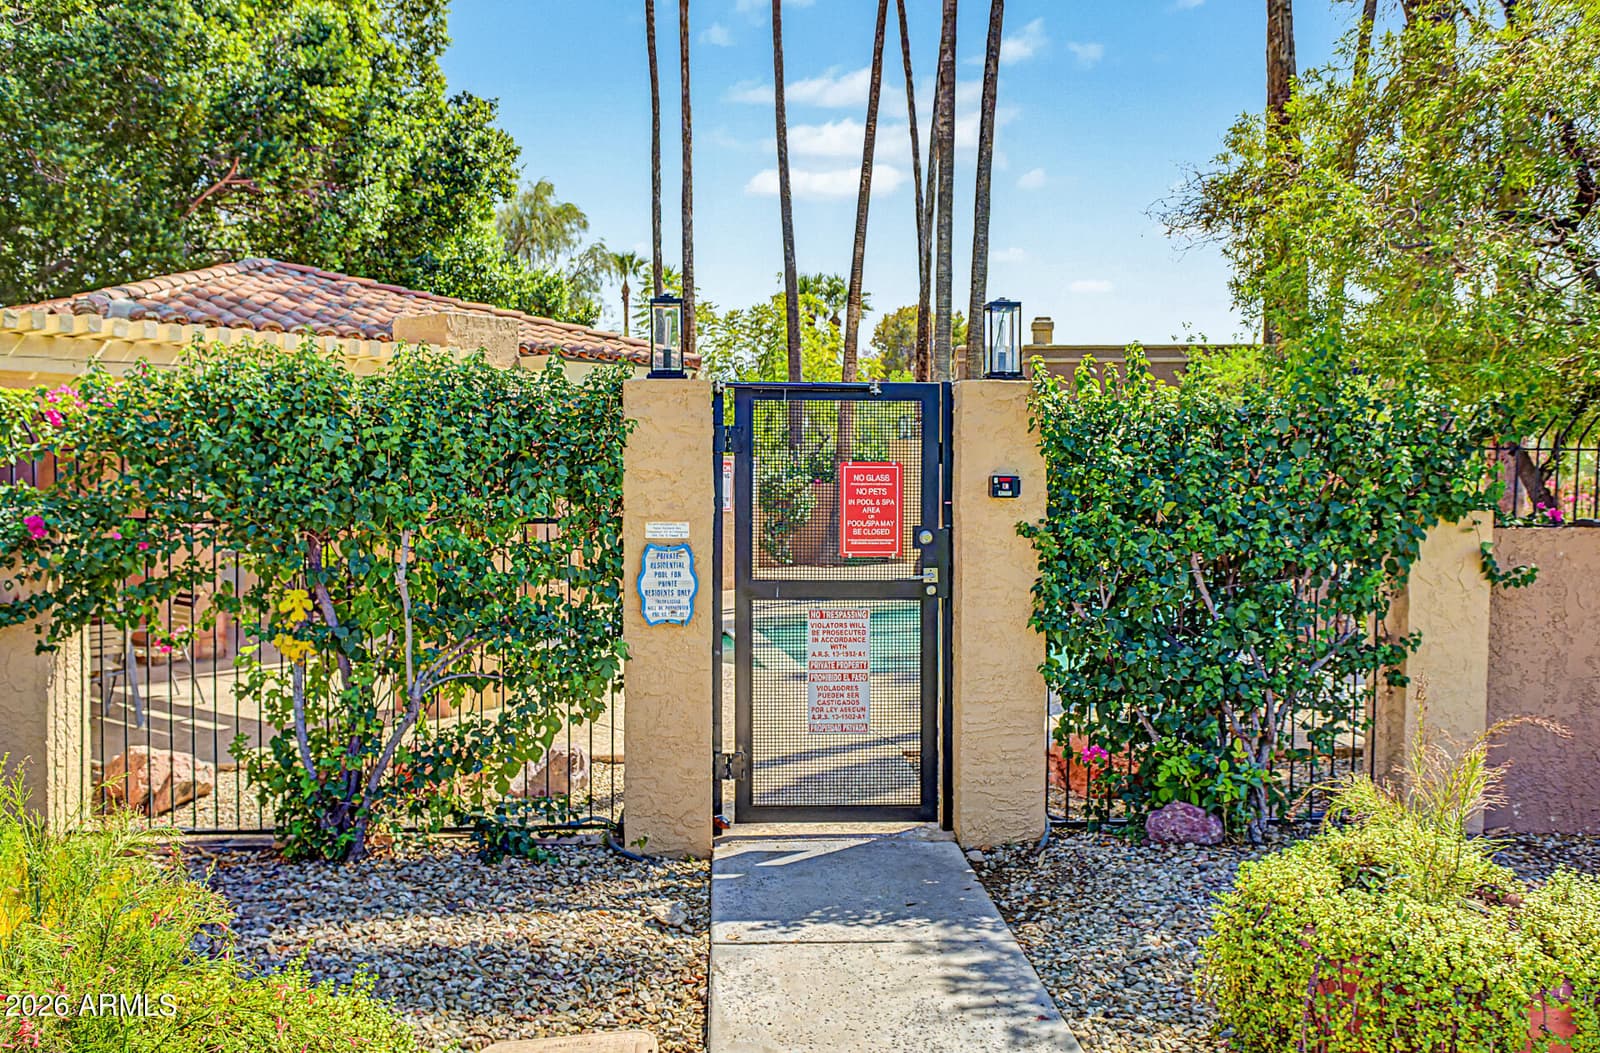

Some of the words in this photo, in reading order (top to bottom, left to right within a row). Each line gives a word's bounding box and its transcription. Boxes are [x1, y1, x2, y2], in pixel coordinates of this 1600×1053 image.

[810, 610, 820, 619] NO
[822, 610, 867, 619] TRESPASSING
[811, 661, 836, 669] PRIVATE
[837, 661, 867, 669] PROPERTY
[811, 673, 842, 681] PROHIBIDO
